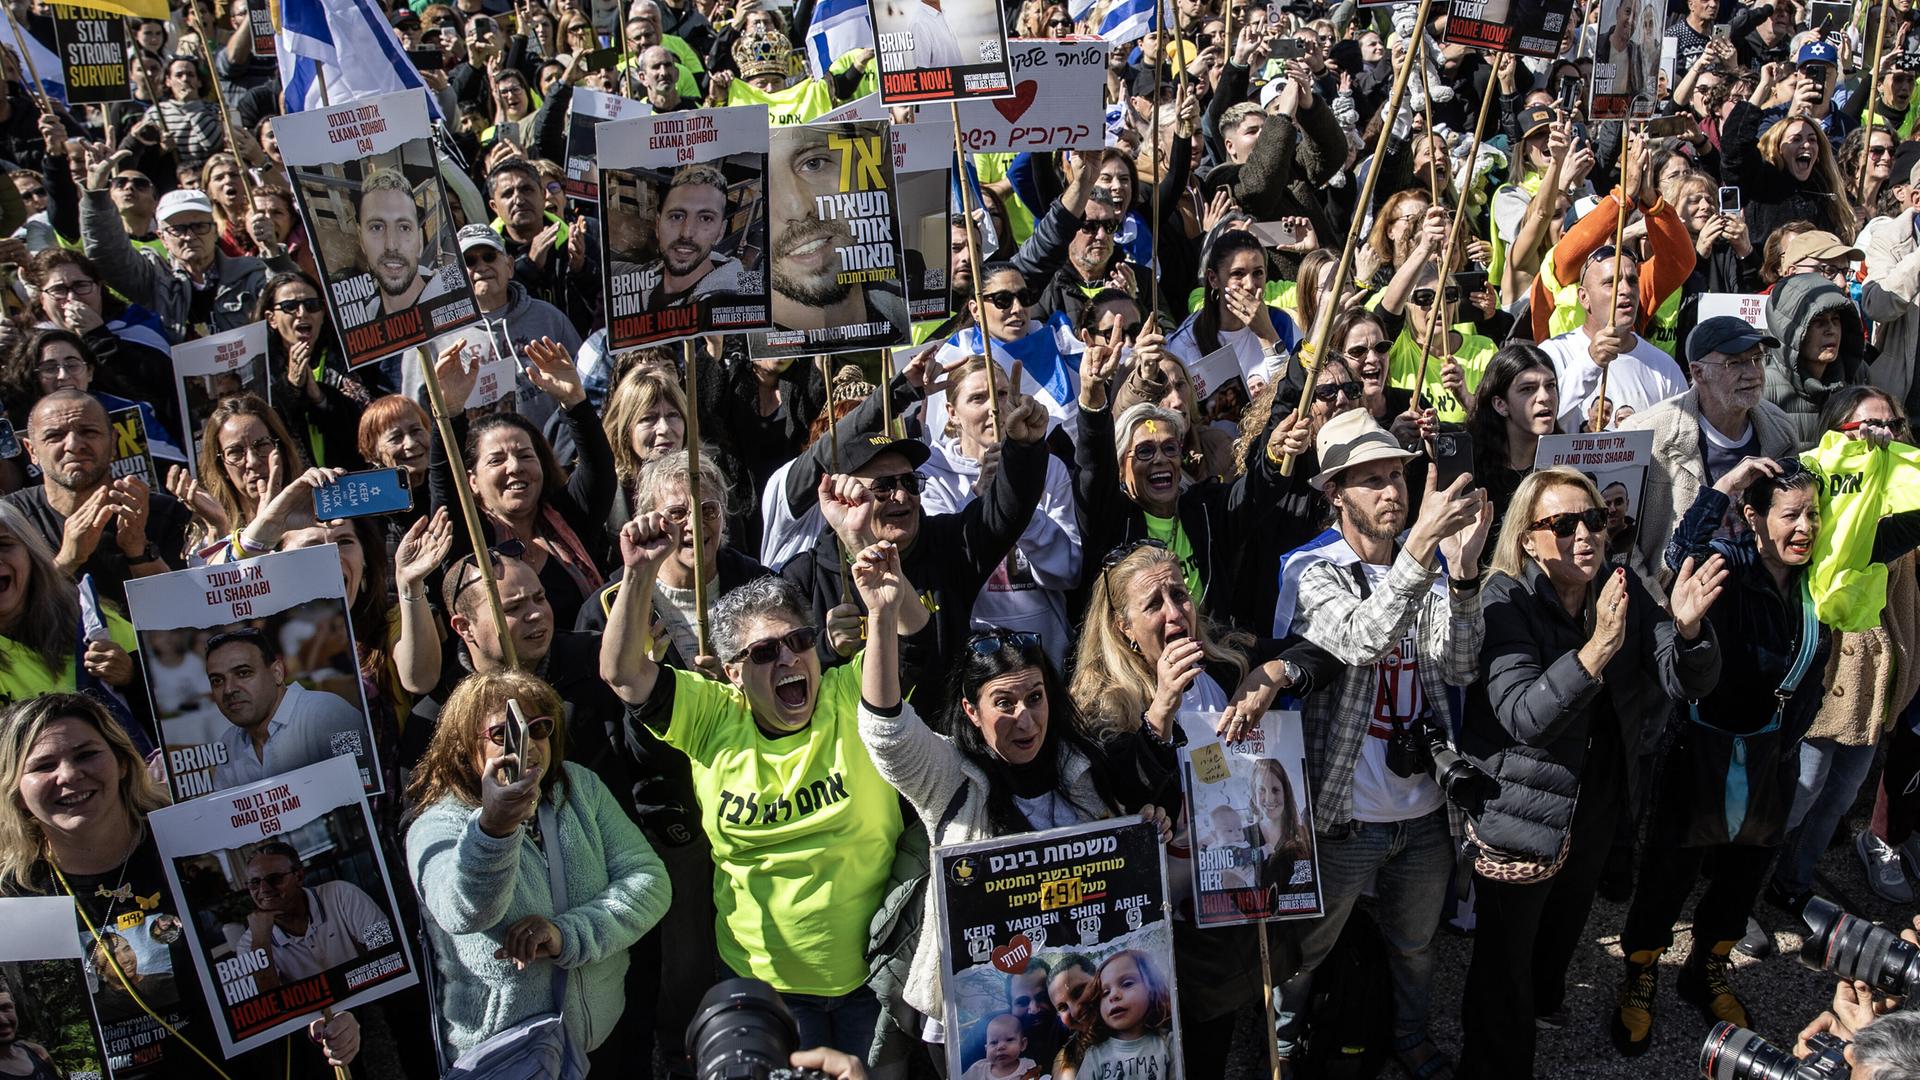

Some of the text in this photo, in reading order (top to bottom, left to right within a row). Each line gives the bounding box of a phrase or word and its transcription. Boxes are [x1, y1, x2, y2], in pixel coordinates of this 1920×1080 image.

[1454, 2, 1484, 20] THEM
[76, 21, 108, 42] STAY
[253, 22, 272, 35] THE
[1449, 18, 1479, 38] HOME
[68, 42, 122, 65] STRONG!
[879, 31, 914, 53] BRING
[881, 53, 905, 73] HIM
[1055, 46, 1101, 67] סליחה
[69, 64, 125, 87] SURVIVE!
[884, 68, 952, 93] HOME NOW!
[1595, 63, 1617, 78] BRING
[965, 78, 1007, 91] FAMILIES FORUM
[1595, 79, 1613, 94] THEM
[327, 104, 380, 128] אלקנה בוחבוט
[654, 115, 714, 135] אלקנה בוחבוט
[779, 113, 802, 125] אתם
[328, 118, 388, 144] ELKANA BOHBOT
[650, 129, 719, 150] ELKANA BOHBOT
[1008, 124, 1090, 148] ברוכים
[356, 136, 374, 155] (34)
[677, 146, 695, 163] (34)
[567, 168, 581, 180] HIM
[568, 157, 590, 172] BRING
[828, 133, 887, 193] אל
[815, 190, 891, 222] תשאירו
[848, 215, 893, 244] אותי
[835, 242, 895, 271] מאחור
[611, 270, 656, 297] BRING
[836, 267, 897, 285] אלקנה בוחבוט
[331, 272, 376, 306] BRING
[338, 300, 369, 330] HIM
[612, 294, 640, 318] HIM
[712, 310, 766, 324] FAMILIES FORUM
[1740, 307, 1761, 316] OR LEVY
[345, 322, 386, 355] HOME
[385, 306, 425, 342] NOW!
[613, 303, 698, 340] HOME NOW!
[1438, 391, 1456, 412] לא
[112, 418, 143, 460] א
[1572, 439, 1595, 451] שרעבי
[1613, 437, 1626, 449] אלי
[109, 454, 147, 479] תשא
[1553, 450, 1635, 465] ELI AND YOSSI SHARABI
[320, 486, 332, 514] AMAS
[331, 484, 342, 508] FUCK
[347, 481, 359, 507] CALM
[359, 482, 370, 503] KEEP
[206, 565, 264, 588] אלי שרעבי
[206, 580, 271, 606] ELI SHARABI
[232, 600, 253, 619] (51)
[169, 741, 229, 775] BRING
[1230, 743, 1251, 756] (33)
[175, 769, 214, 799] HIM
[232, 783, 291, 812] אוהד בן עמי
[718, 772, 850, 826] אתם לא לבד
[230, 795, 301, 829] OHAD BEN AMI
[260, 816, 282, 836] (55)
[989, 835, 1118, 874] משפחת ביבס
[1198, 849, 1235, 871] BRING
[984, 856, 1126, 894] מוחזקים בשבי החמאס
[1081, 879, 1107, 894] מעל
[1200, 870, 1223, 892] HER
[1044, 881, 1079, 906] 491
[1201, 887, 1269, 914] HOME NOW!
[1279, 899, 1316, 910] FAMILIES FORUM
[122, 913, 143, 925] 491
[1005, 911, 1060, 932] YARDEN
[1070, 902, 1106, 920] SHIRI
[1114, 893, 1152, 912] ARIEL
[968, 937, 994, 957] (2)
[1076, 917, 1101, 936] (33)
[1126, 907, 1143, 929] (5)
[215, 948, 271, 984] BRING
[1000, 943, 1029, 968] חזרתי
[348, 958, 405, 990] FAMILIES FORUM
[222, 974, 260, 1006] HIM
[230, 972, 333, 1031] HOME NOW!
[111, 1037, 132, 1053] FOR
[131, 1031, 152, 1048] YOU
[152, 1027, 167, 1041] TO
